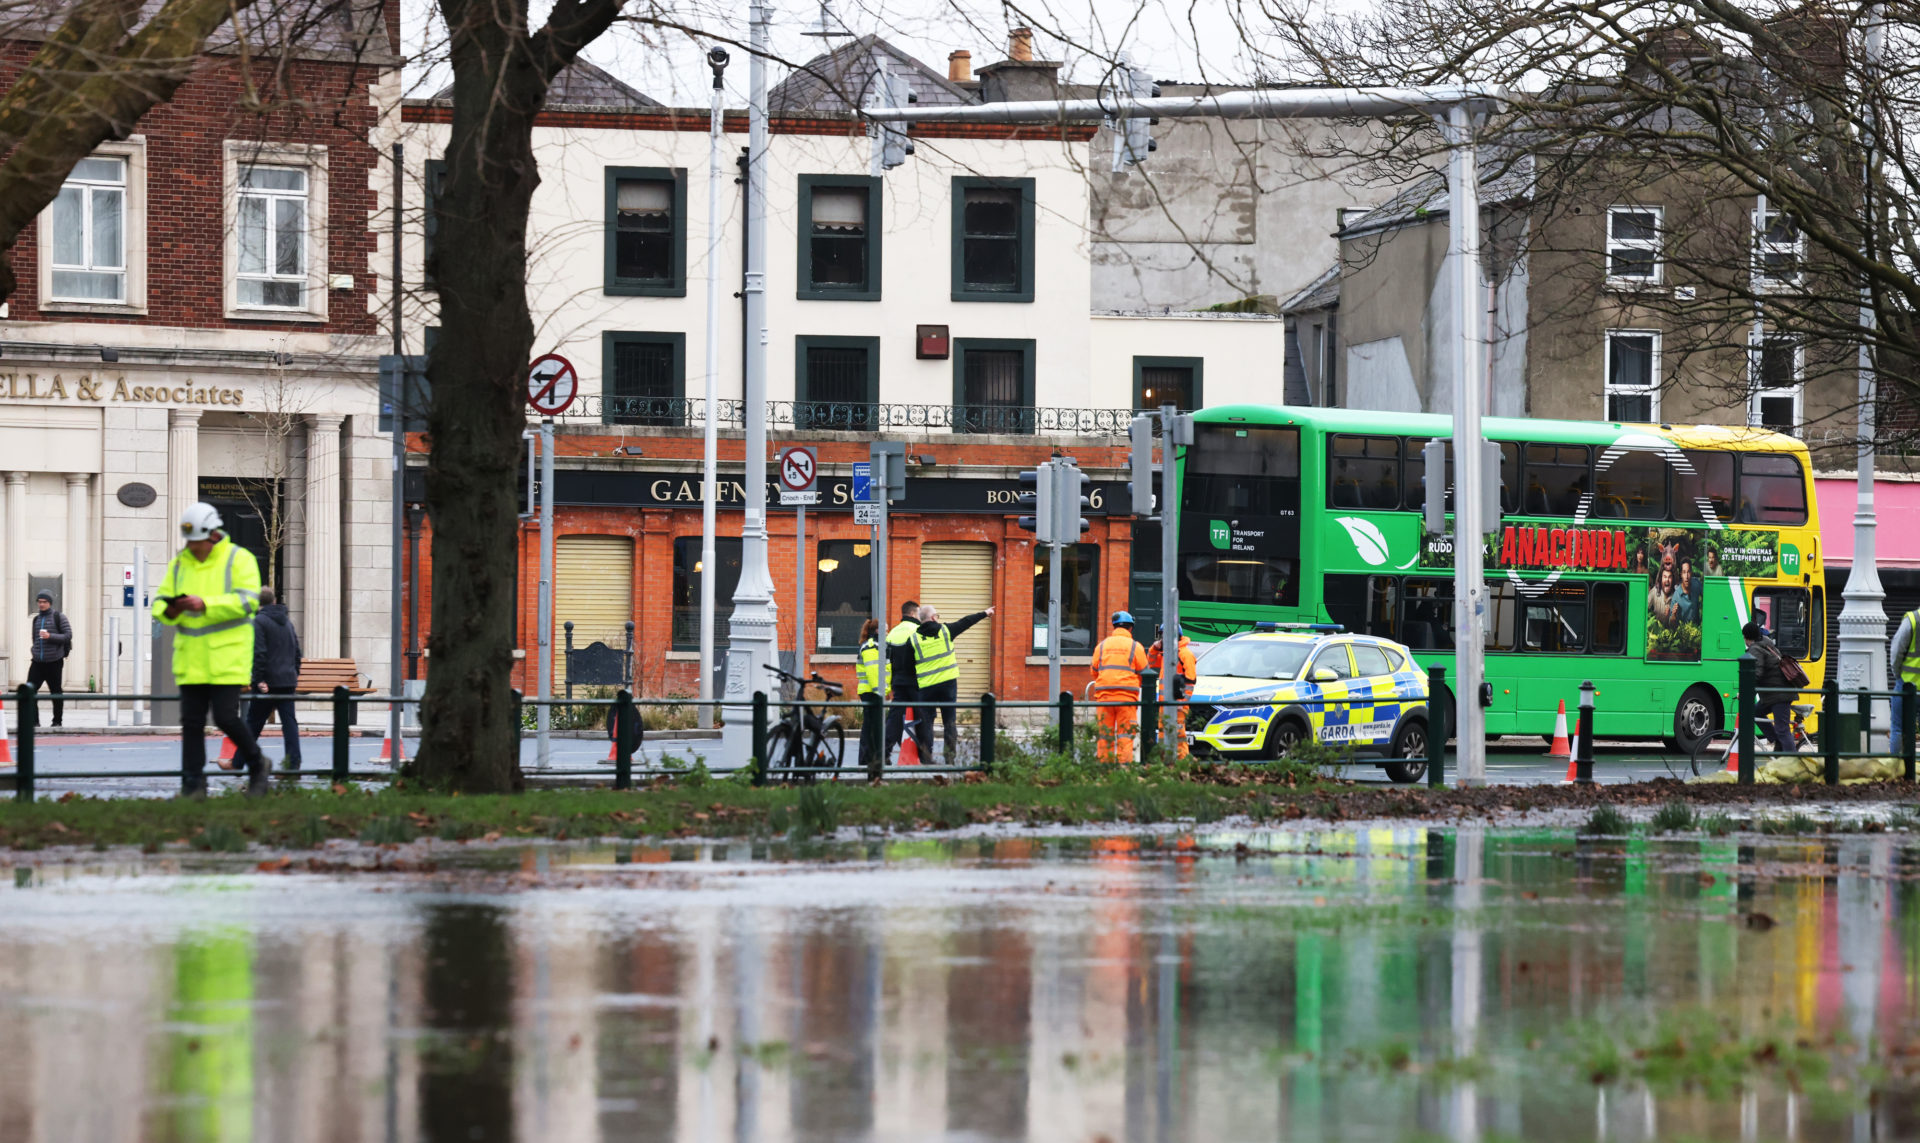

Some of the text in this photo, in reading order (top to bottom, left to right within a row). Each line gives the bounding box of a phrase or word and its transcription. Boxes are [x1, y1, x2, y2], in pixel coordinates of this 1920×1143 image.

[77, 375, 103, 401] &
[111, 376, 244, 405] Associates
[987, 490, 1036, 504] BON
[858, 510, 868, 518] 24
[1213, 529, 1228, 540] TFI
[1428, 542, 1452, 553] RUDD
[1500, 526, 1628, 569] ANACONDA
[1782, 554, 1798, 566] TFI
[1321, 726, 1356, 740] GARDA
